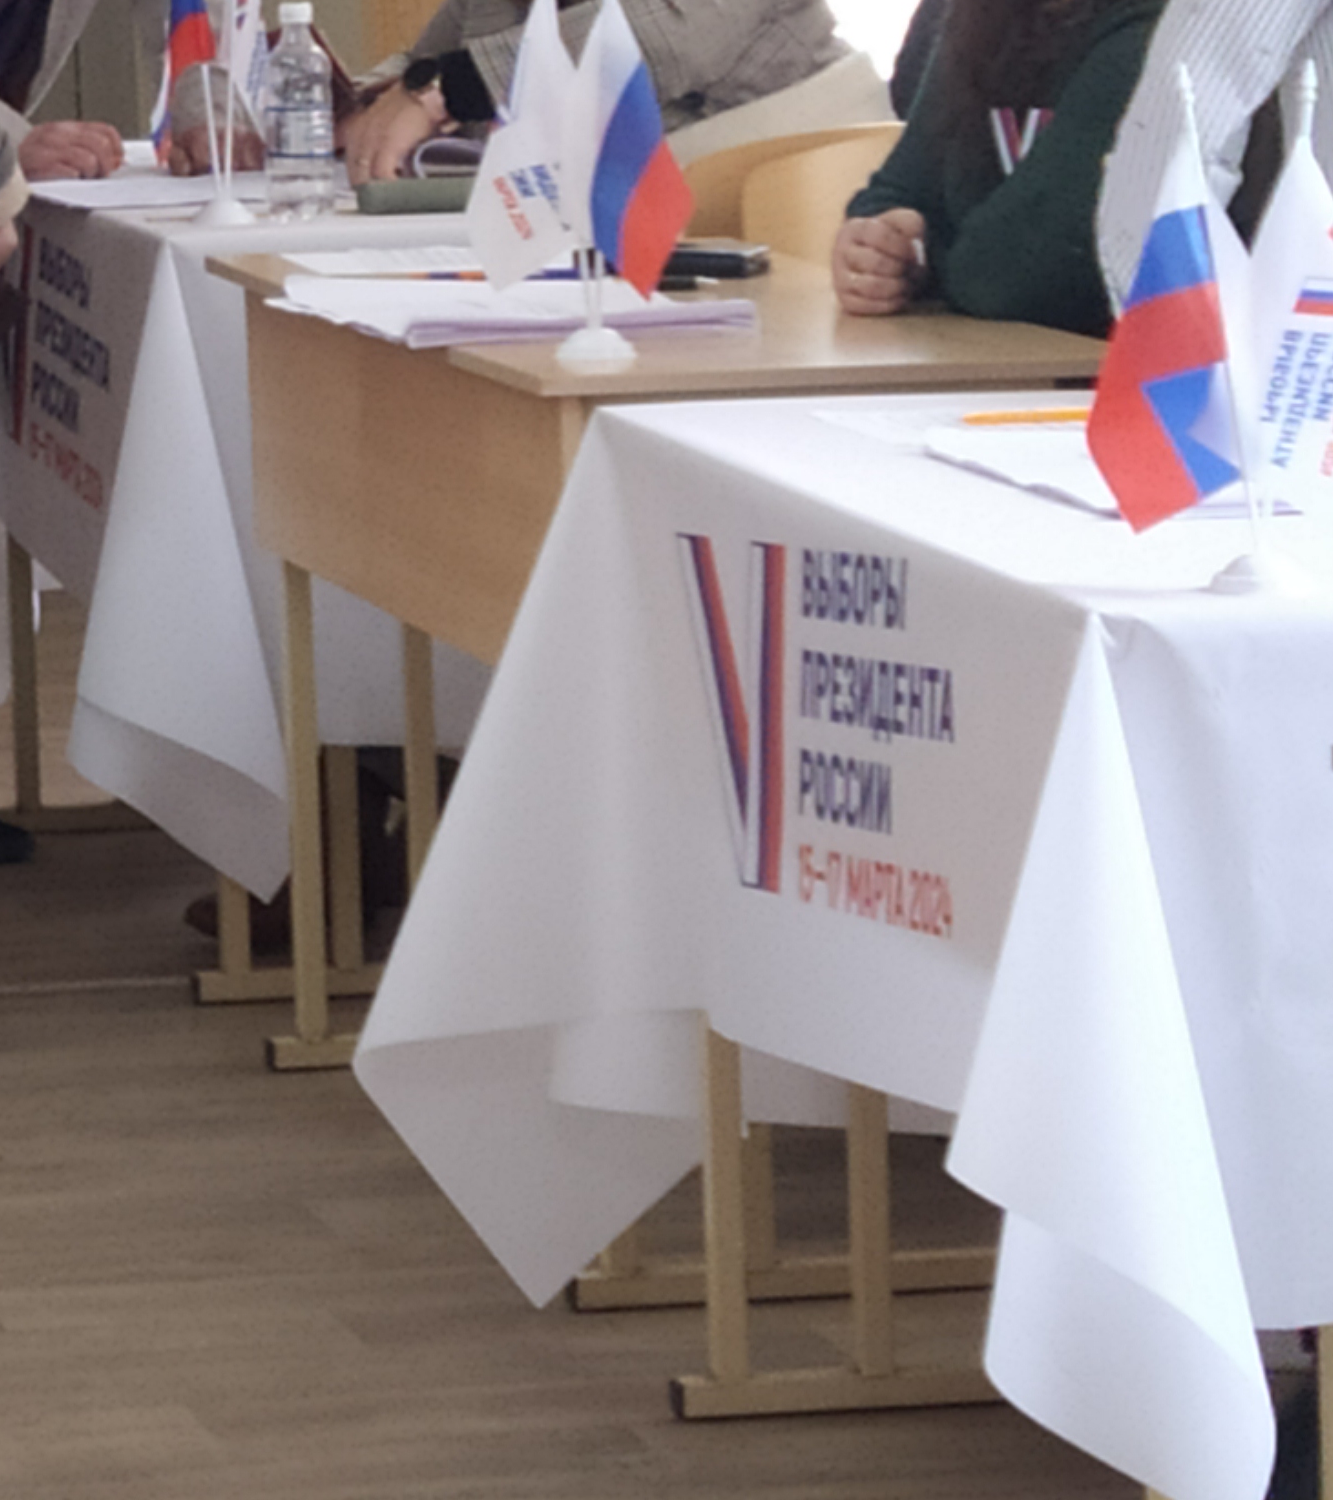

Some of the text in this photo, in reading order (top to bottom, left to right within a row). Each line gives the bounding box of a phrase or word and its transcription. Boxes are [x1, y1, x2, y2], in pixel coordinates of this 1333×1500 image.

[800, 548, 908, 630] ВЫБОРЫ
[799, 648, 955, 744] ПРЕЗИДЕНТА
[798, 747, 892, 835] РОССИИ
[844, 855, 905, 924] МАРТА
[906, 869, 953, 940] 2024
